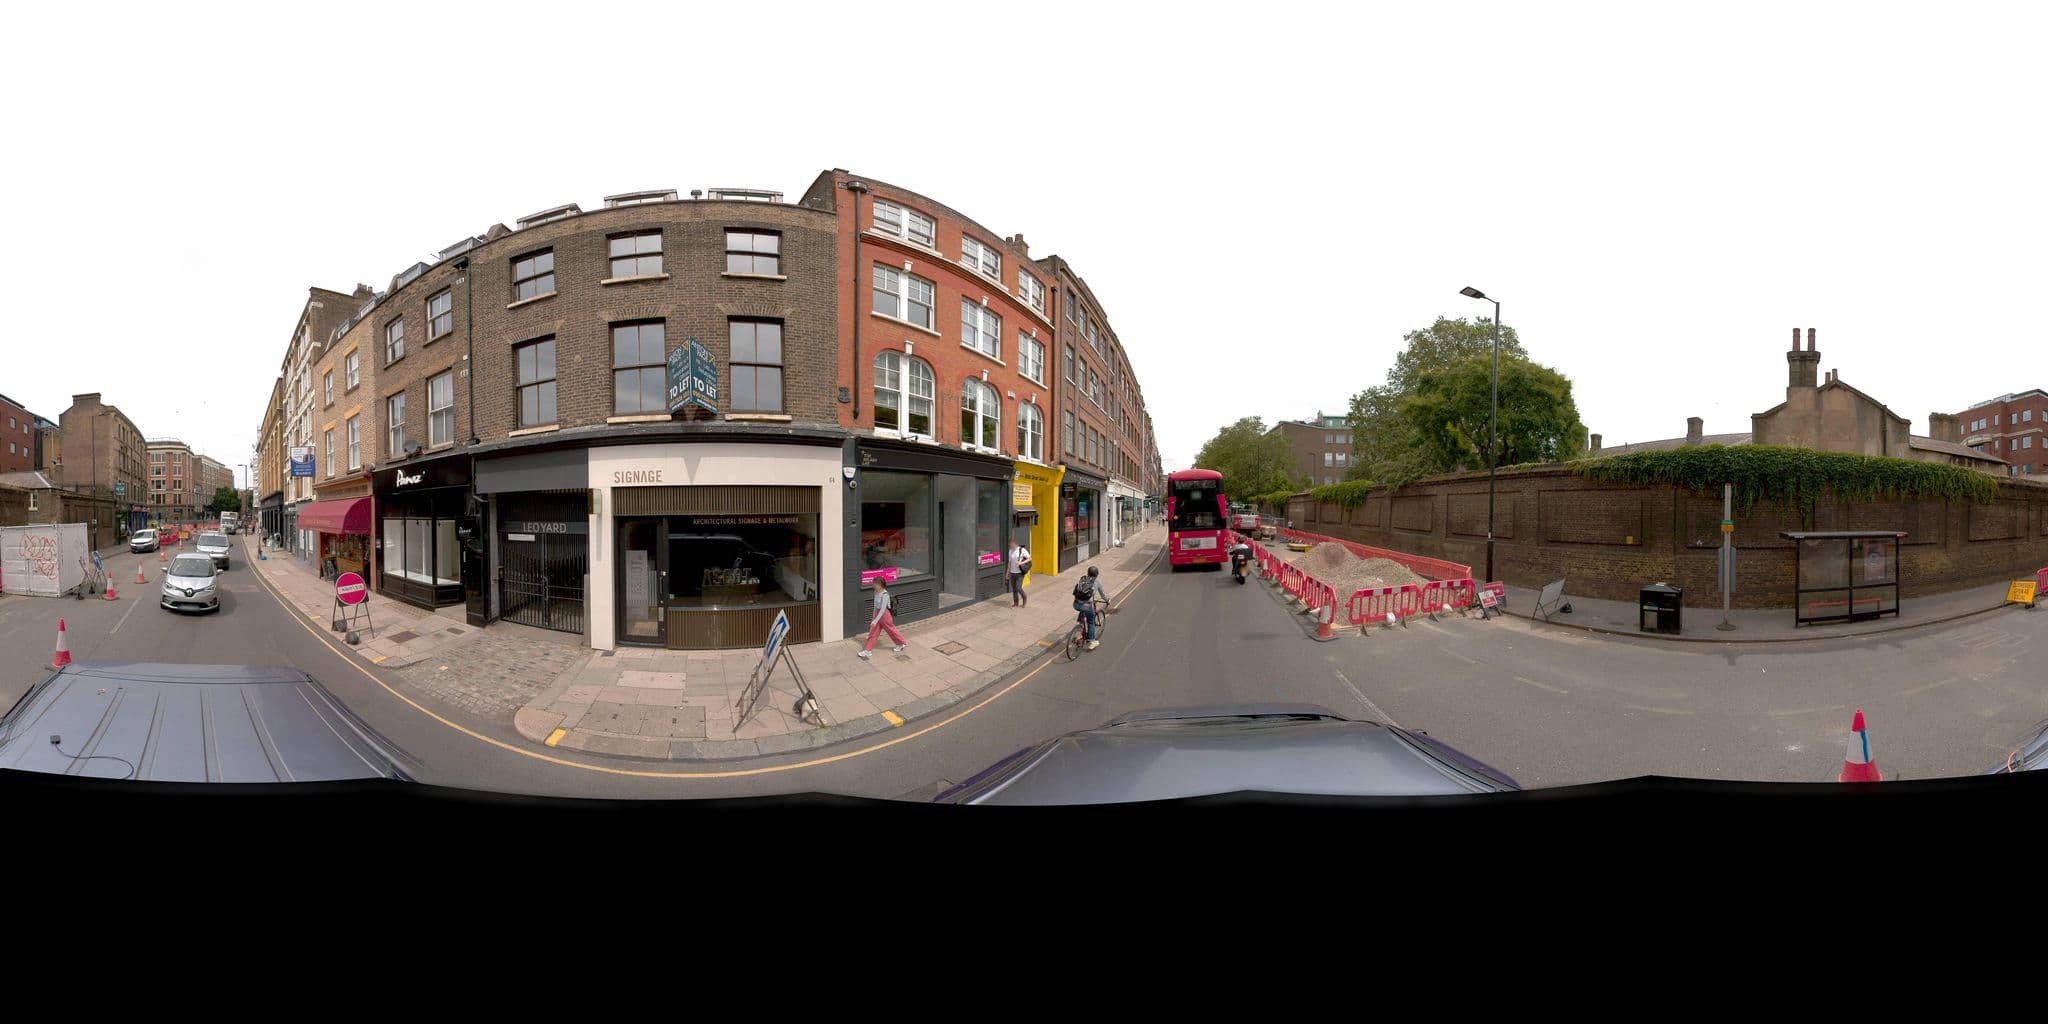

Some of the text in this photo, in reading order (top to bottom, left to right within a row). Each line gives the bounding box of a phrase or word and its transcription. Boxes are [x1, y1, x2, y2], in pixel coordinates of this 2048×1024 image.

[670, 386, 678, 399] TO
[680, 376, 690, 393] LET
[693, 376, 704, 392] TO
[706, 384, 717, 399] LET
[614, 469, 662, 483] SIGNAGE
[523, 521, 567, 533] LEO YARD
